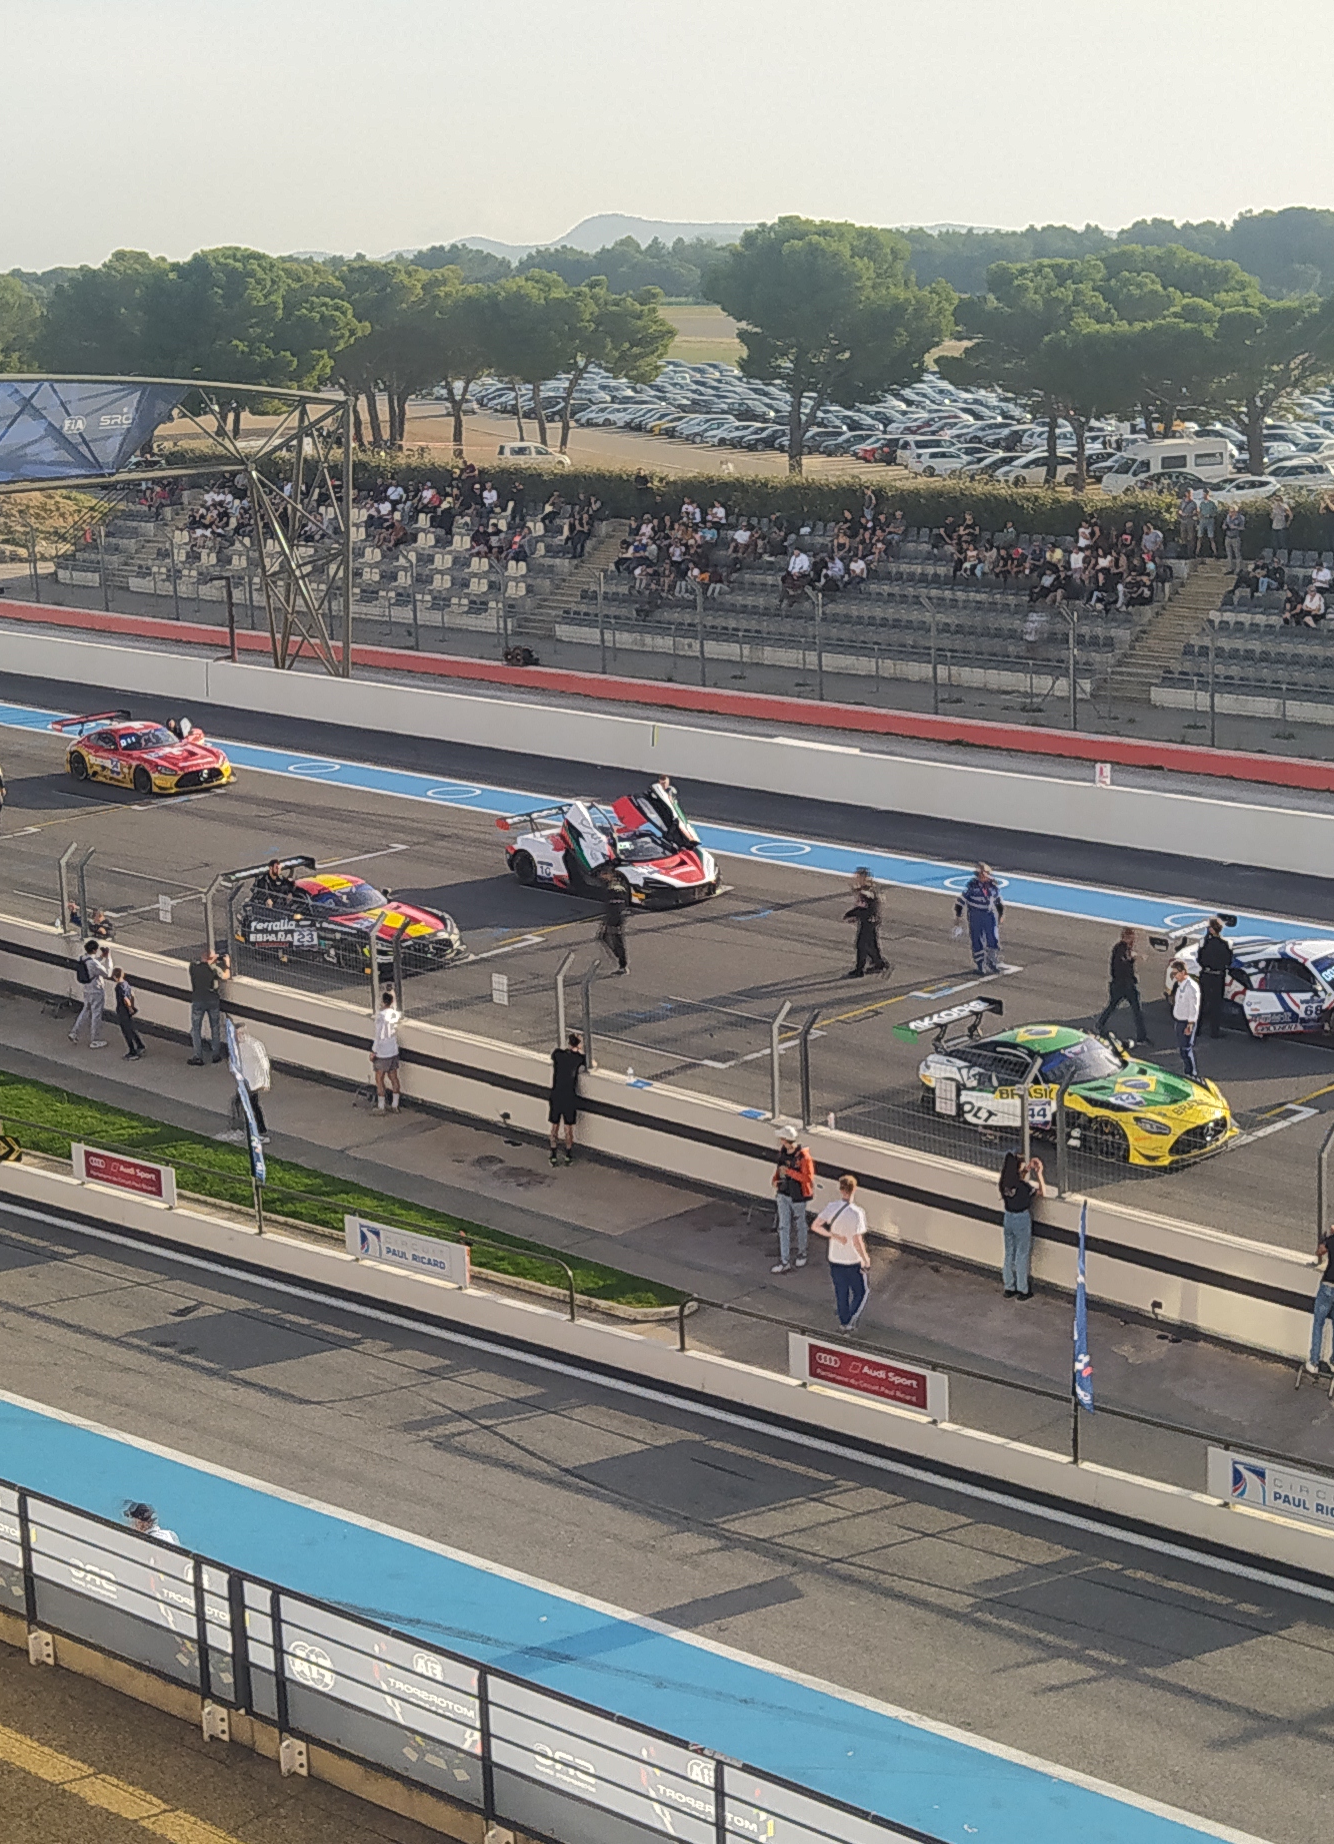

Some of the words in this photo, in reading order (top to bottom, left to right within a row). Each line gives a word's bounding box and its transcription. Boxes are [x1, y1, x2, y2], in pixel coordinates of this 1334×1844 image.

[99, 413, 132, 425] SRO
[297, 932, 315, 943] 23
[1304, 1005, 1322, 1016] 68
[119, 1165, 135, 1175] Audi
[136, 1169, 156, 1181] Sport
[386, 1247, 408, 1260] PAUL
[412, 1254, 446, 1270] RICARD
[862, 1366, 887, 1380] Audi
[887, 1372, 918, 1389] Sport
[1273, 1491, 1310, 1511] PAUL
